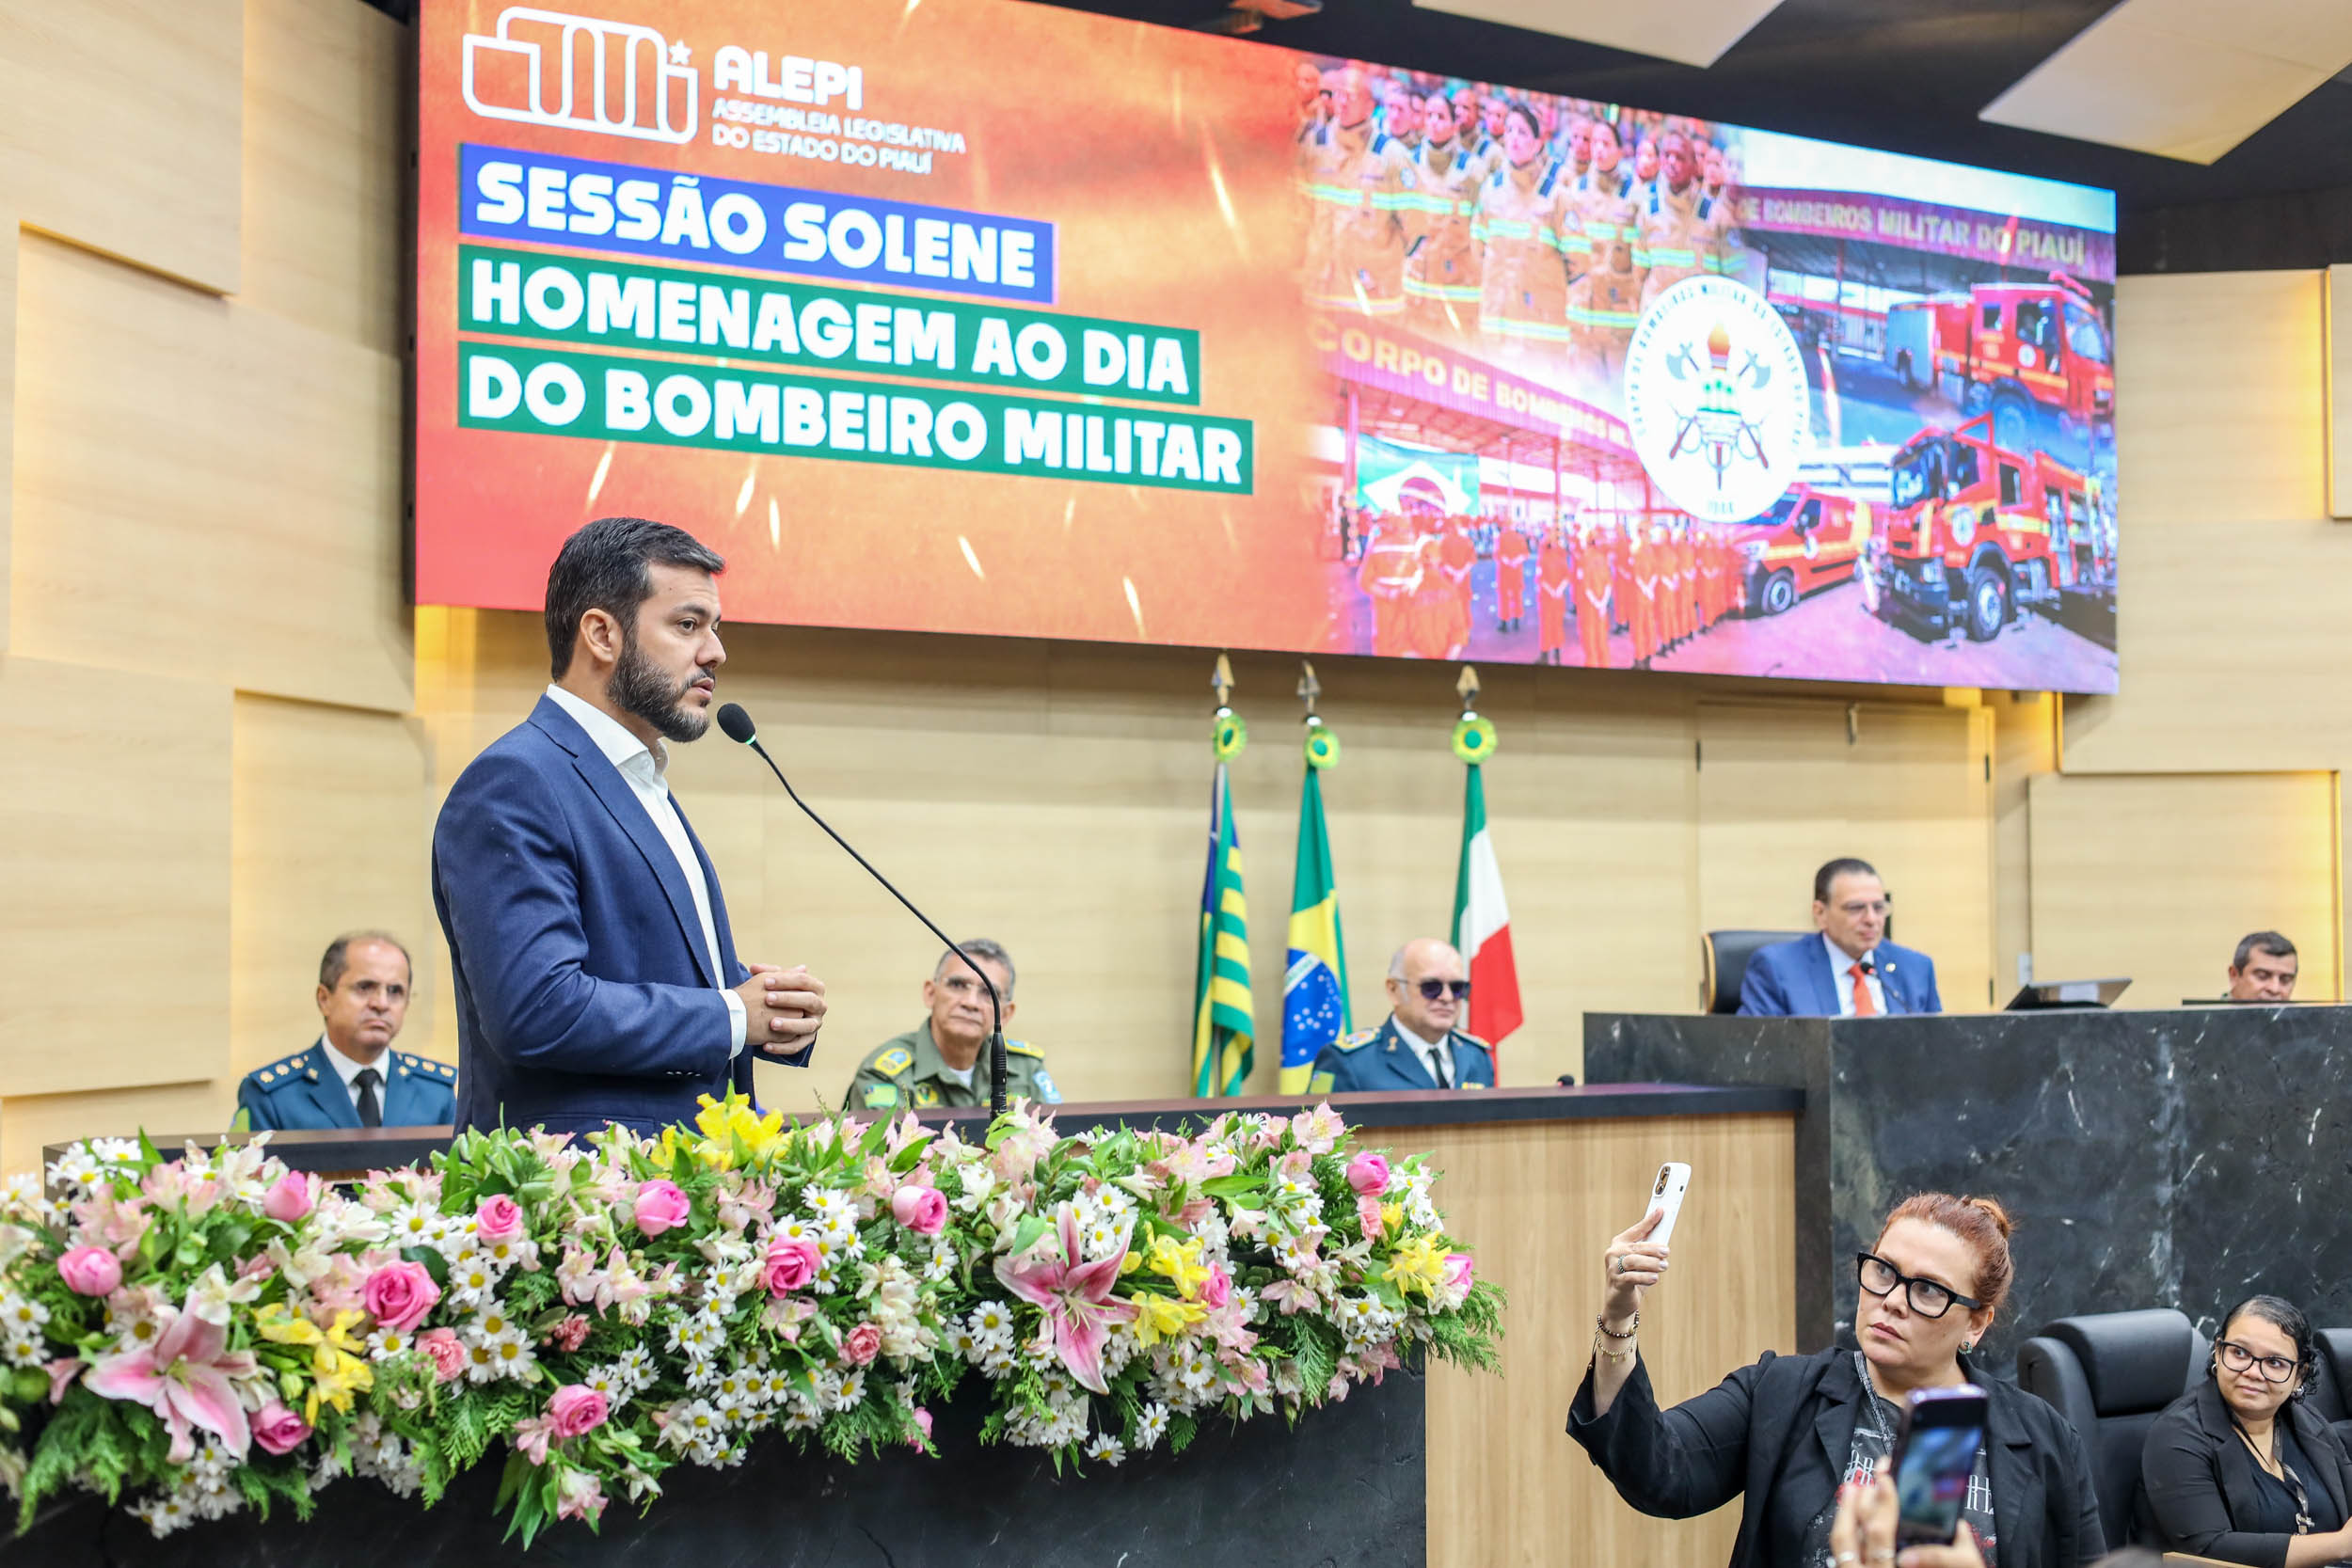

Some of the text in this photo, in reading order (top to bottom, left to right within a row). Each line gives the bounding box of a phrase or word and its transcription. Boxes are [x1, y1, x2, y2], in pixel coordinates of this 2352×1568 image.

[713, 44, 864, 111] ALEPI
[711, 97, 966, 153] ASSEMBLEIA LEGISLATIVA
[711, 122, 750, 149] DO
[752, 129, 839, 162] ESTADO
[840, 142, 878, 166] DO
[476, 161, 1036, 288] SESSÃO SOLENE
[1877, 208, 1971, 249] MILITAR
[470, 259, 1190, 395] HOMENAGEM AO DIA
[1452, 364, 1490, 403] DE
[468, 355, 1243, 484] DO BOMBEIRO MILITAR
